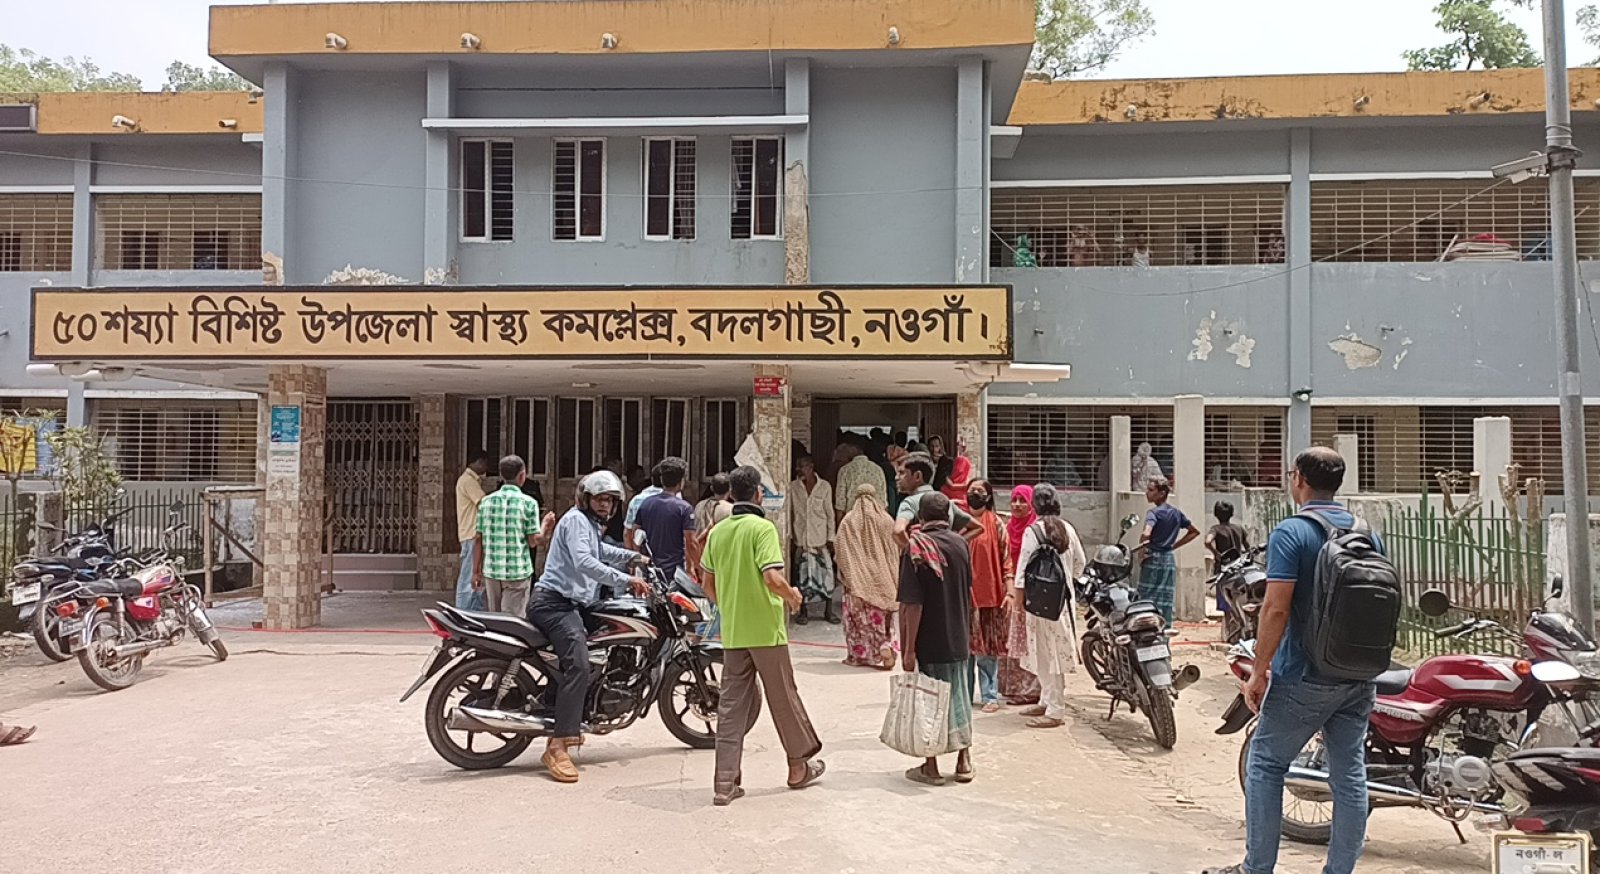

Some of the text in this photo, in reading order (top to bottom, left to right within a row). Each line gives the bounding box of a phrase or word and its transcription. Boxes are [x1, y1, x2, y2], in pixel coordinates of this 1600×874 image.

[187, 294, 286, 344] বিশিষ্ট
[296, 296, 438, 344] উপজেলা
[446, 301, 530, 345] স্বাস্থ্য
